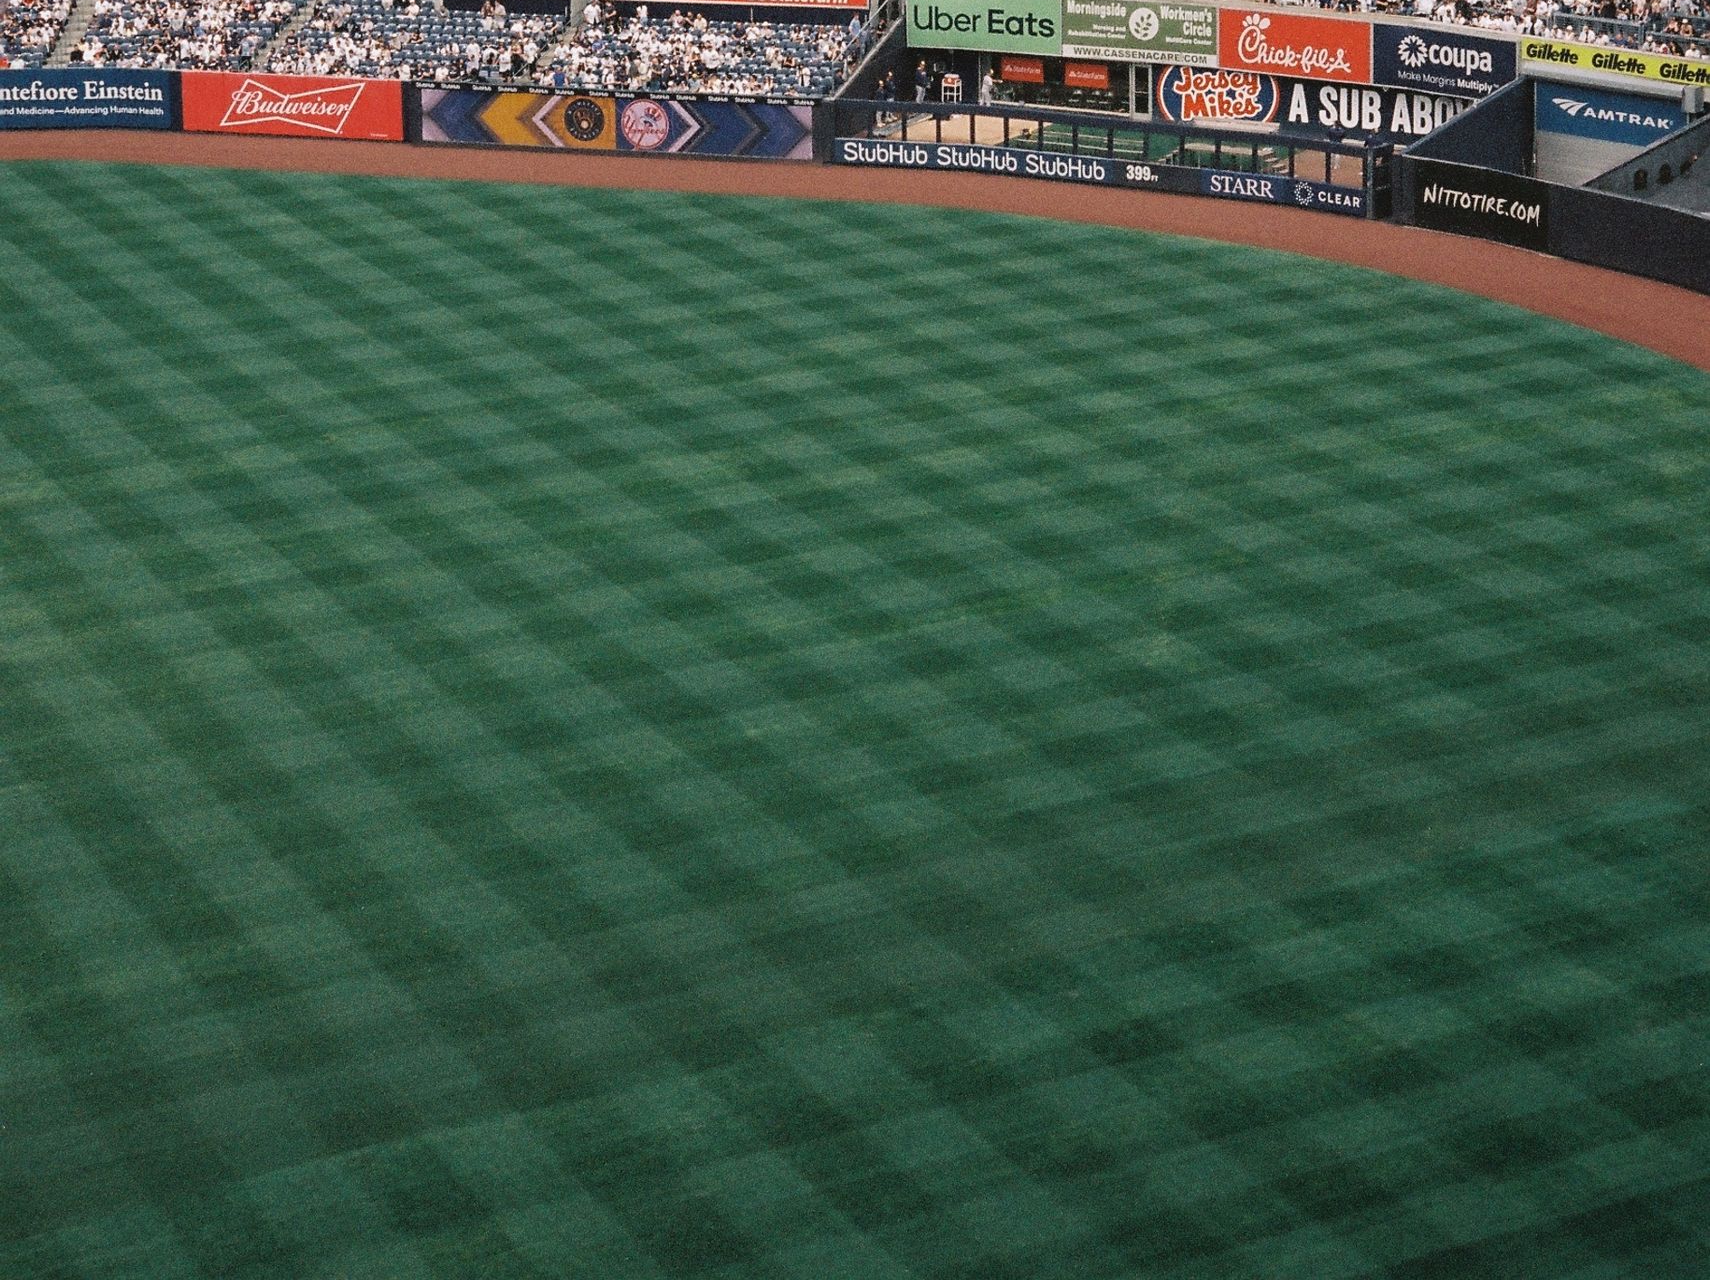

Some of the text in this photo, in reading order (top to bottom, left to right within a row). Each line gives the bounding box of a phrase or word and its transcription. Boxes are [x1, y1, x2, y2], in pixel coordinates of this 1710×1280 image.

[913, 4, 1055, 38] Uber Eats
[1067, 0, 1127, 19] Morningside
[1160, 5, 1213, 23] Workmen's
[1182, 21, 1212, 37] Circle
[1073, 47, 1208, 64] WWW.CASSENACARE.COM
[1238, 25, 1352, 74] Chick-fil-A
[1428, 44, 1492, 76] coupa
[1526, 43, 1579, 65] Gillette
[1591, 53, 1647, 75] Gillette
[83, 80, 163, 101] Einstein
[1174, 64, 1260, 96] Jersey
[1397, 70, 1422, 81] Make
[1422, 74, 1456, 88] Margins
[110, 105, 138, 114] Human
[139, 106, 164, 116] Health
[231, 89, 350, 117] Budweiser
[1181, 90, 1262, 120] Mike's
[1289, 83, 1309, 124] A
[1318, 86, 1381, 130] SUB
[1583, 106, 1669, 130] AMTRAK
[844, 142, 1105, 181] StubHub StubHub StubHub
[1210, 175, 1274, 199] STARR
[1318, 190, 1361, 209] CLEAR
[1423, 183, 1541, 227] NITTOTIRE.COM
